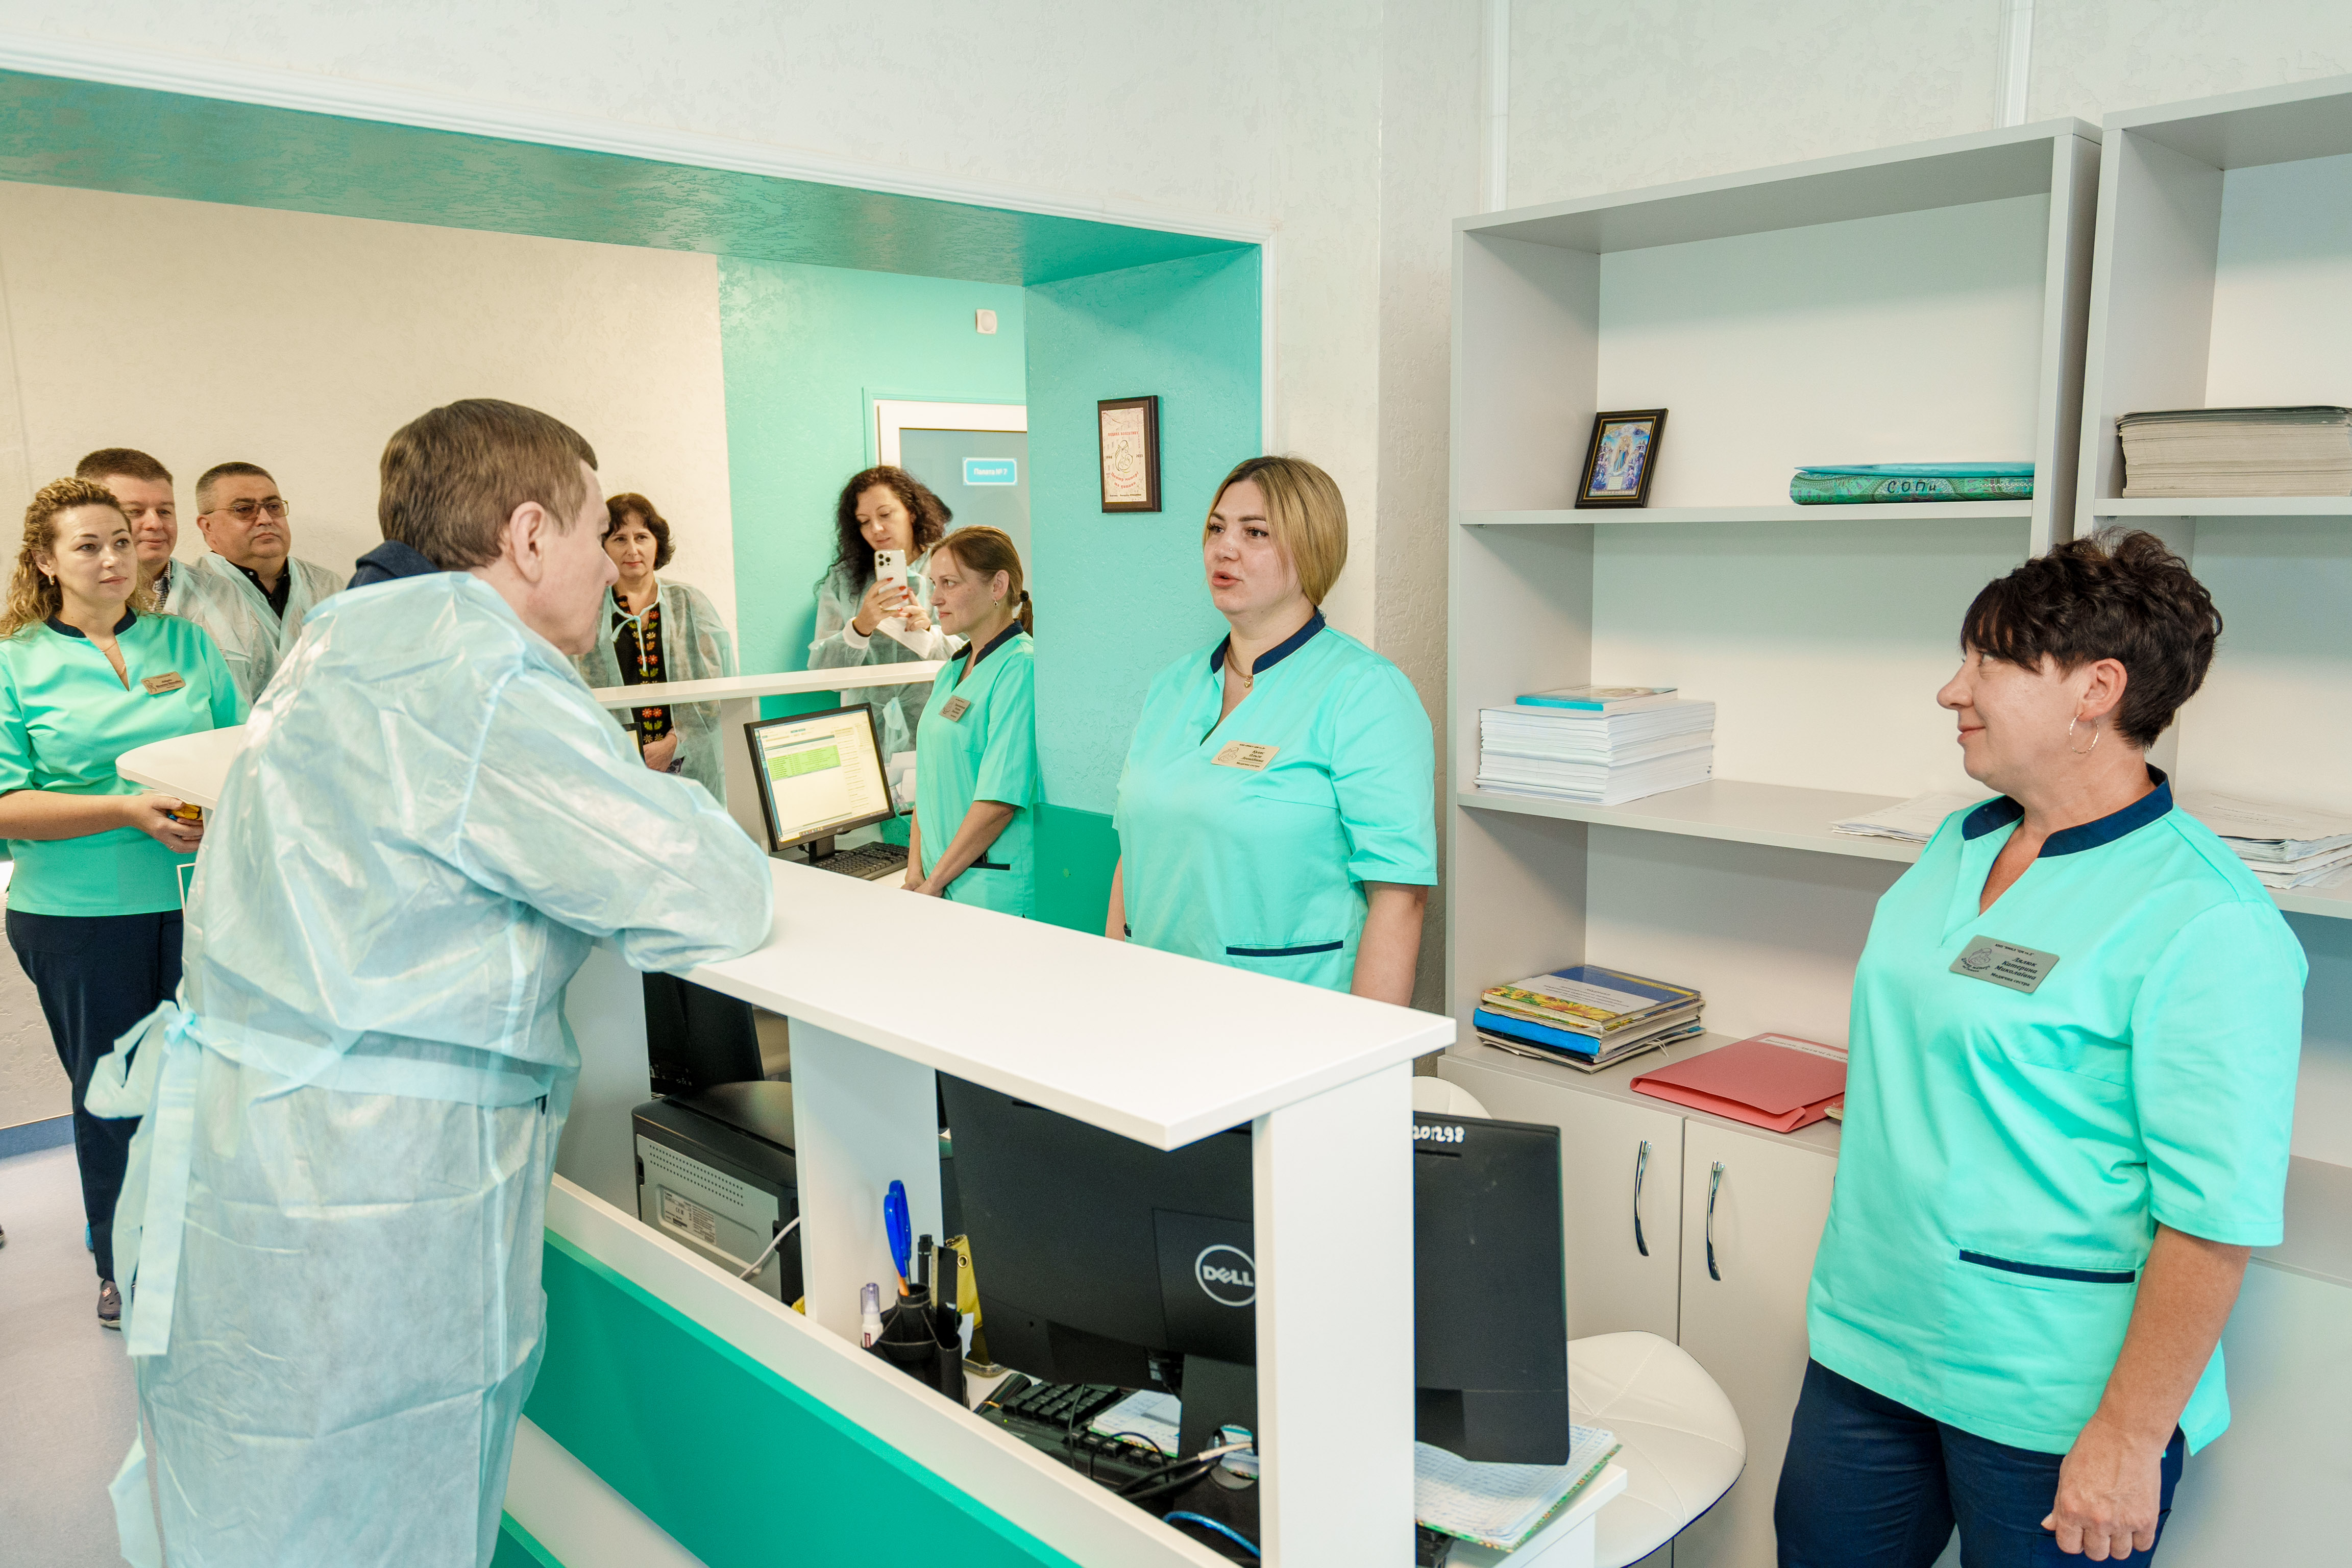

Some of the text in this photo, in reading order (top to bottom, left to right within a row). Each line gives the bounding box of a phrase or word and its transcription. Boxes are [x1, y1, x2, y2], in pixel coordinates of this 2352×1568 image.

[1994, 965, 2037, 980] Миколаївна
[2001, 961, 2038, 974] Катерина
[1991, 972, 2013, 982] Медична
[1203, 1265, 1254, 1287] DELL
